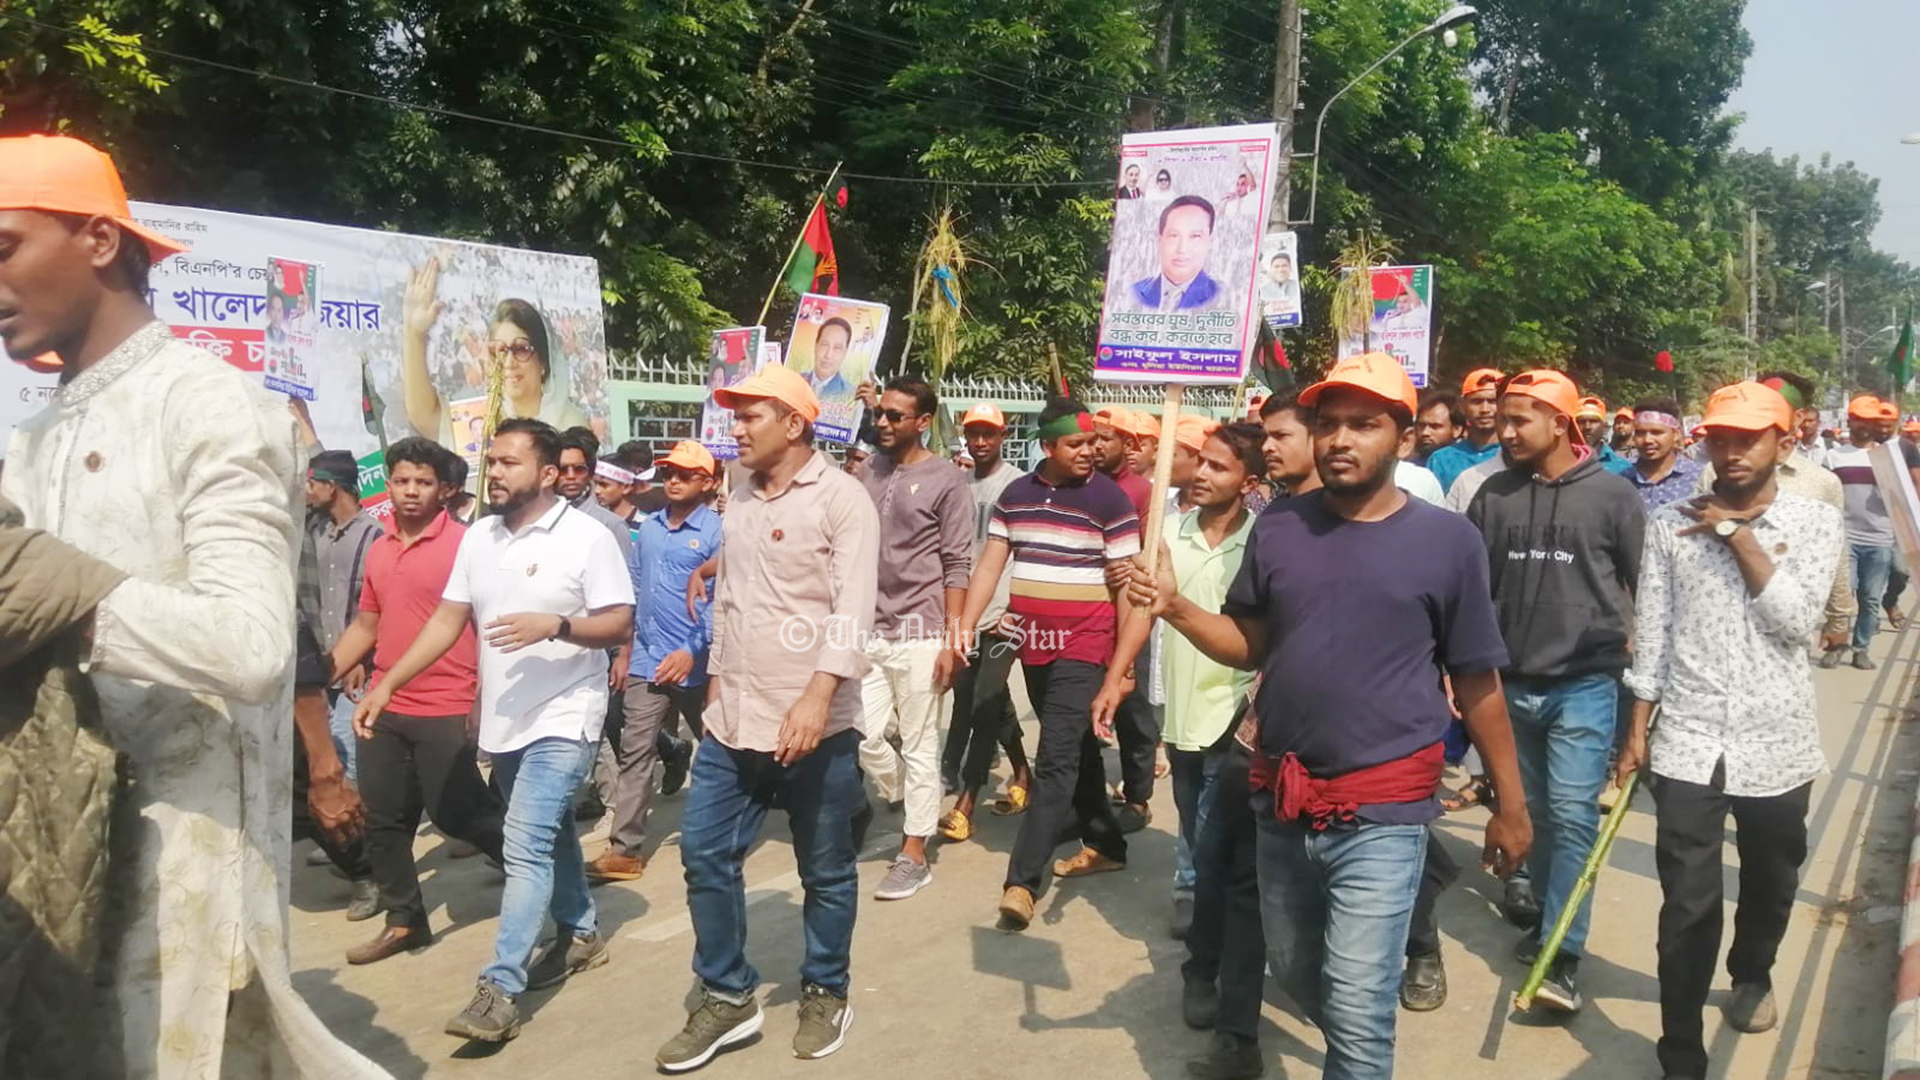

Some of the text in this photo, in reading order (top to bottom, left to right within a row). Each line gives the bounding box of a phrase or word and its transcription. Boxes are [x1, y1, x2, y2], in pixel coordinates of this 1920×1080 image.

[1111, 309, 1237, 331] সর্বস্তরের ঘুষ, দুর্নীতি
[1110, 329, 1133, 343] বন্ধ
[1165, 331, 1206, 344] করতে
[1208, 332, 1233, 345] হবে
[1113, 347, 1239, 364] সাইফুল ইসলাম
[1508, 549, 1527, 560] New
[1554, 550, 1575, 564] City
